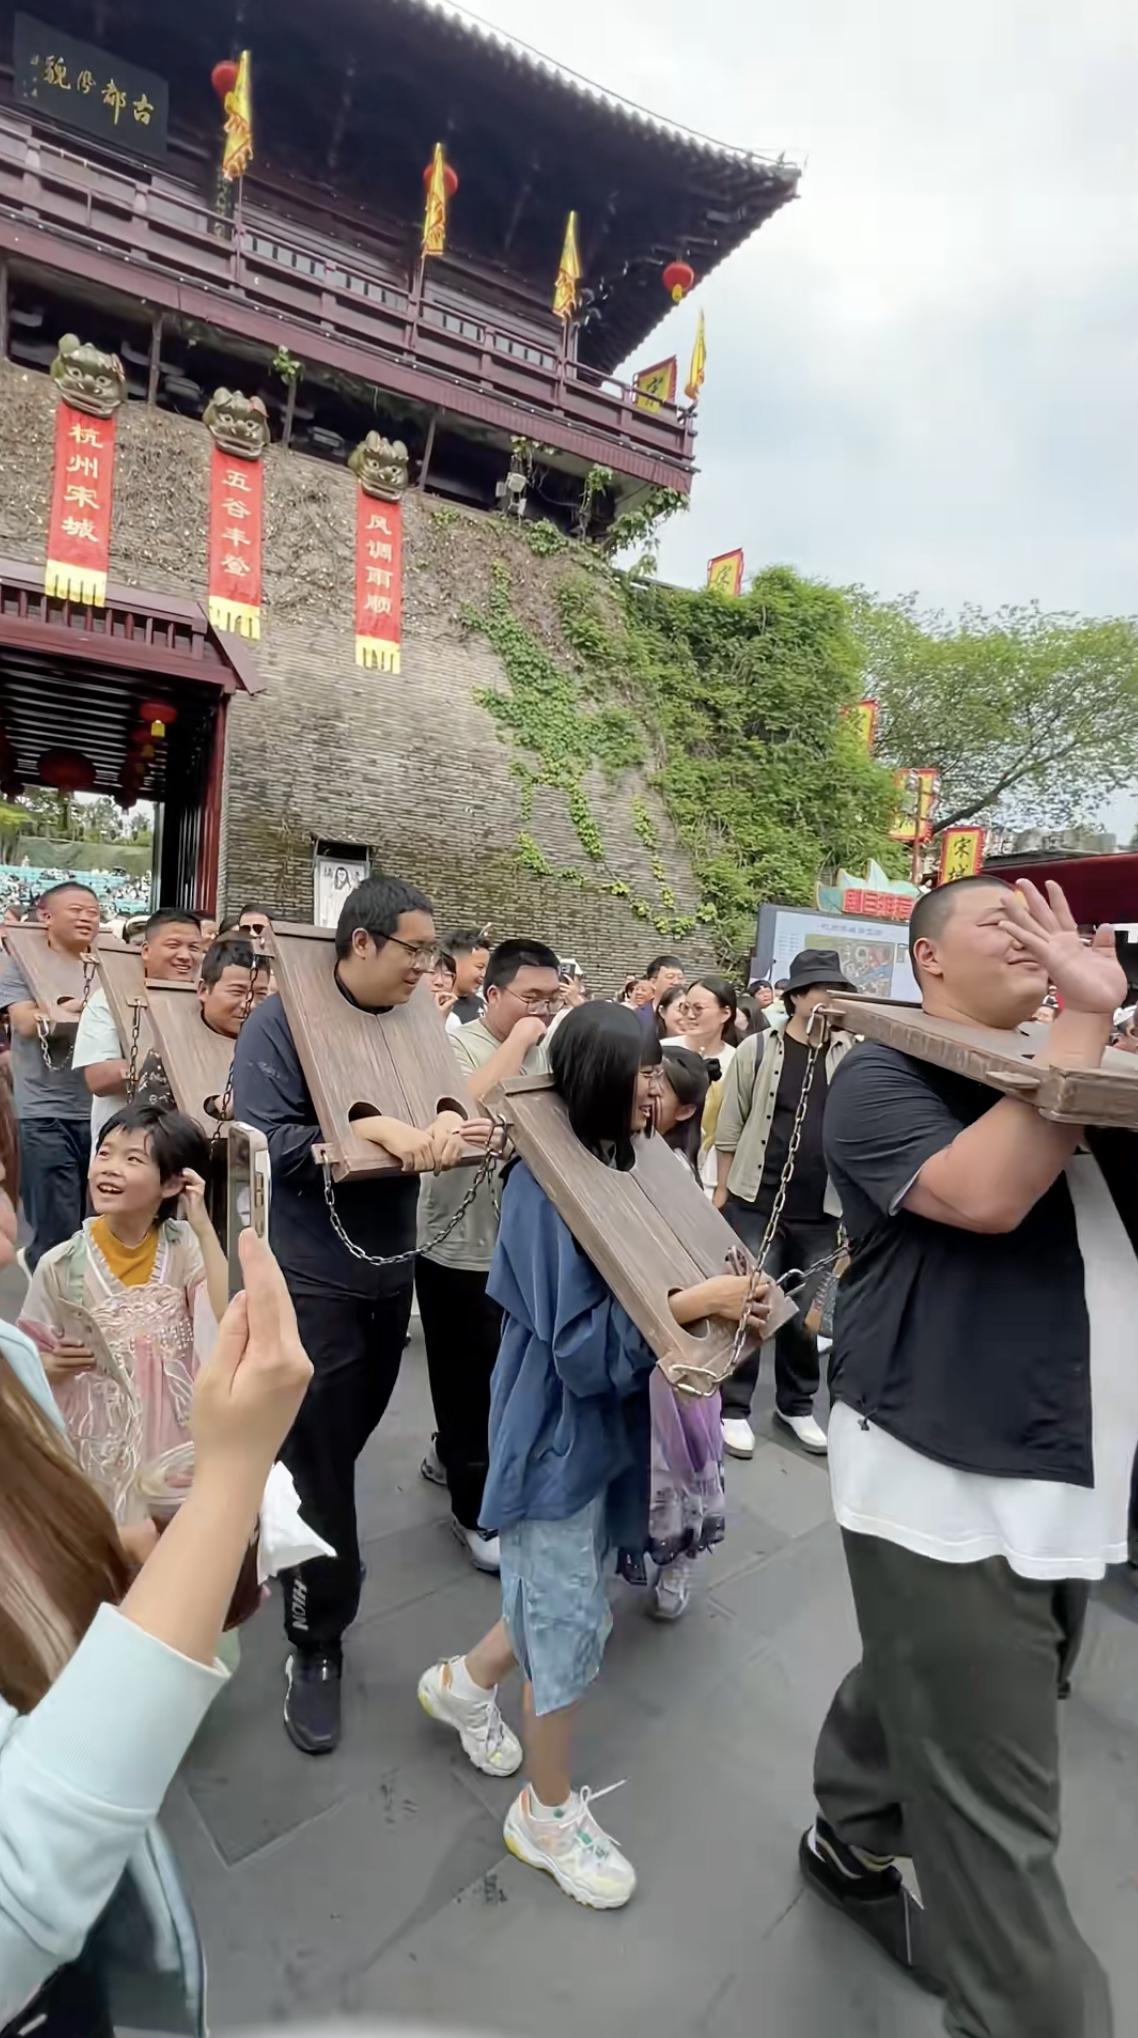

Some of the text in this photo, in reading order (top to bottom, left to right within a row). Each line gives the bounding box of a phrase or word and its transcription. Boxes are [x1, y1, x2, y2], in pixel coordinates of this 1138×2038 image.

[61, 423, 104, 543] 杭州宋城
[220, 469, 252, 577] 五谷丰登
[364, 514, 393, 617] 风调雨顺
[291, 1577, 309, 1631] HION
